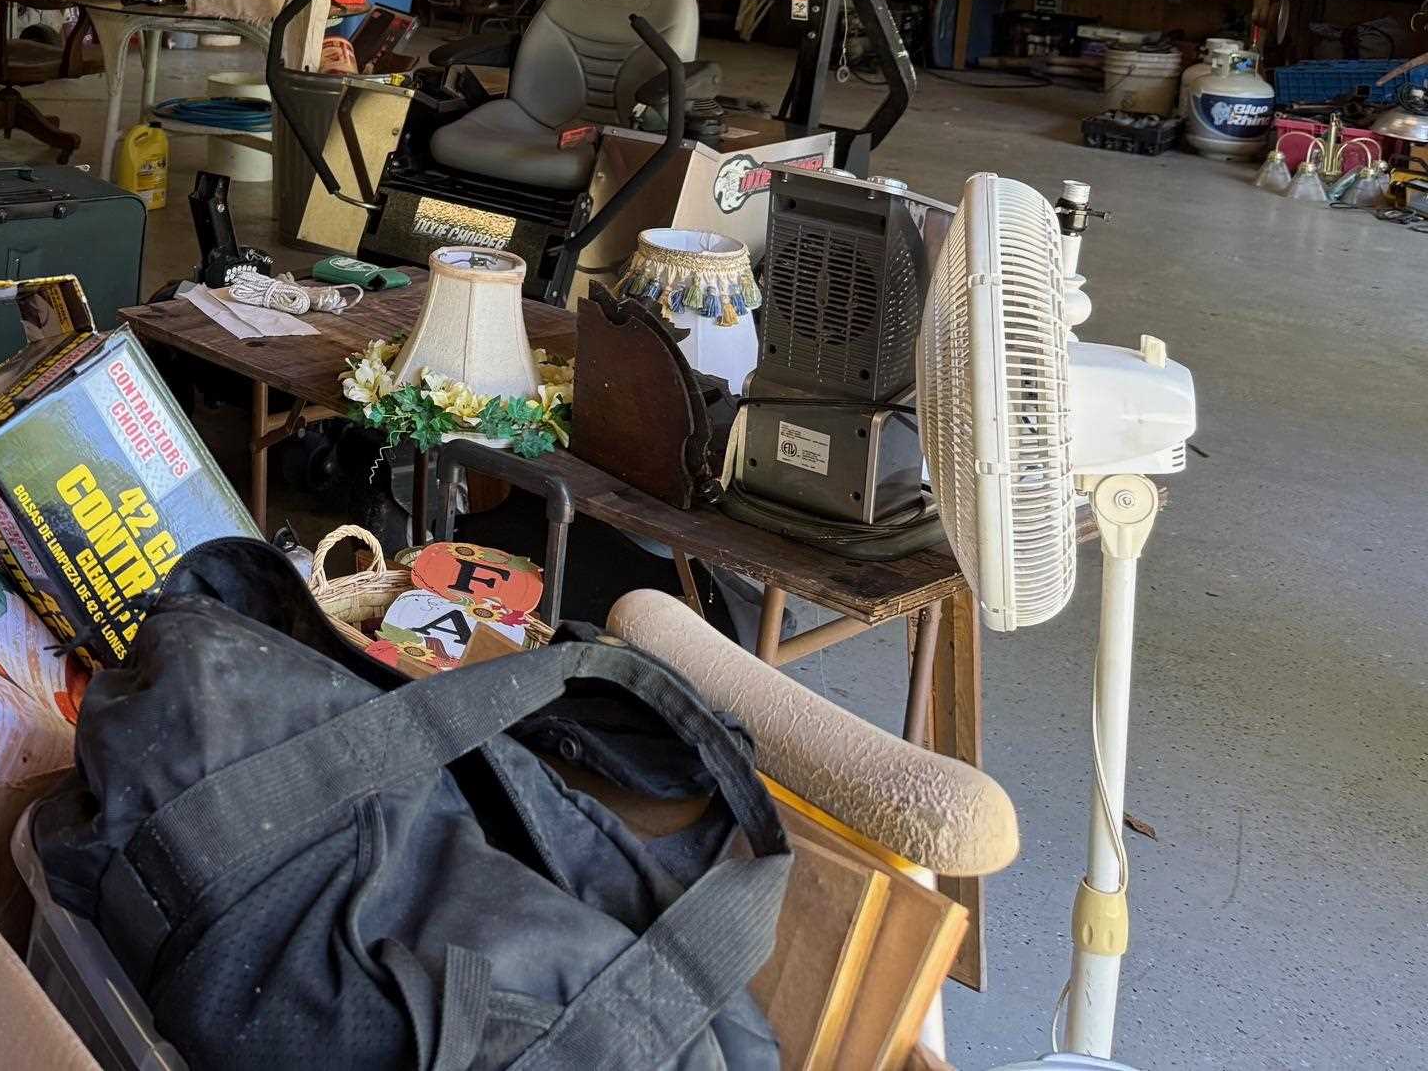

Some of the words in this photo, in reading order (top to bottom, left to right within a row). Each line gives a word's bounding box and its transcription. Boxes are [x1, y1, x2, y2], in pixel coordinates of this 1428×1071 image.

[1232, 103, 1269, 116] Blue
[412, 218, 449, 238] DIXIE
[108, 360, 190, 478] CONTRACTOR'S
[110, 401, 156, 462] CHOICE
[117, 486, 159, 538] 42
[13, 484, 44, 529] BOLSAS
[37, 523, 53, 542] DE
[46, 537, 82, 588] LIMPIEZA
[75, 584, 91, 603] DE
[85, 598, 100, 616] 42
[93, 611, 128, 661] GLONES
[447, 559, 511, 594] F
[410, 610, 472, 645] A
